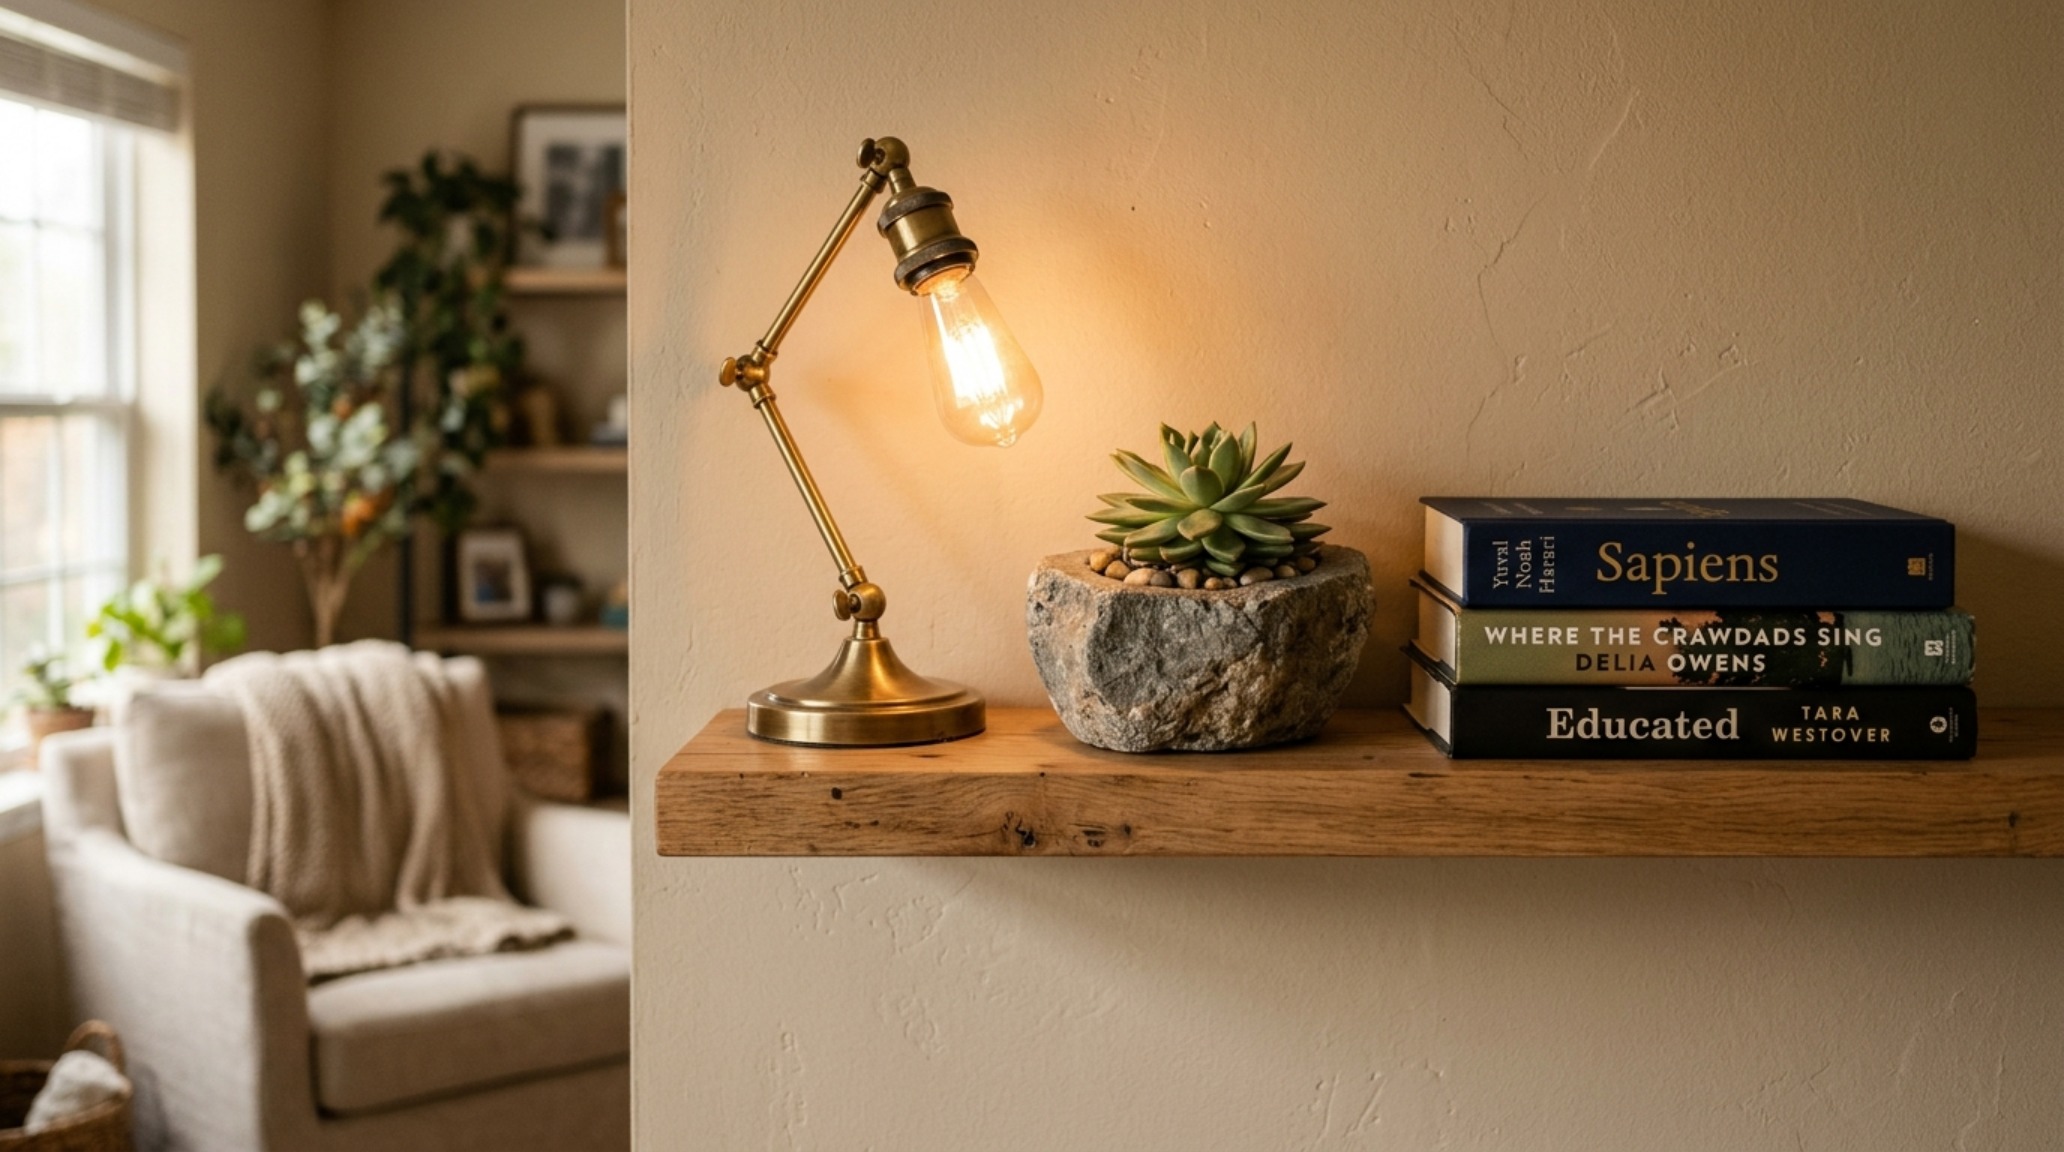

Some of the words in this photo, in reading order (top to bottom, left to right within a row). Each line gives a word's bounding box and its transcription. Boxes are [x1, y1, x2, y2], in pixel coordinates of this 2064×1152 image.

[1597, 541, 1779, 595] Sapiens
[1484, 626, 1579, 645] WHERE
[1590, 627, 1641, 645] THE
[1653, 627, 1807, 646] CRAWDADS
[1817, 627, 1882, 647] SING
[1575, 653, 1655, 671] DELIA
[1667, 653, 1766, 672] OWENS
[1801, 706, 1860, 720] TARA
[1546, 707, 1740, 740] Educated
[1771, 727, 1891, 742] WESTOVER
